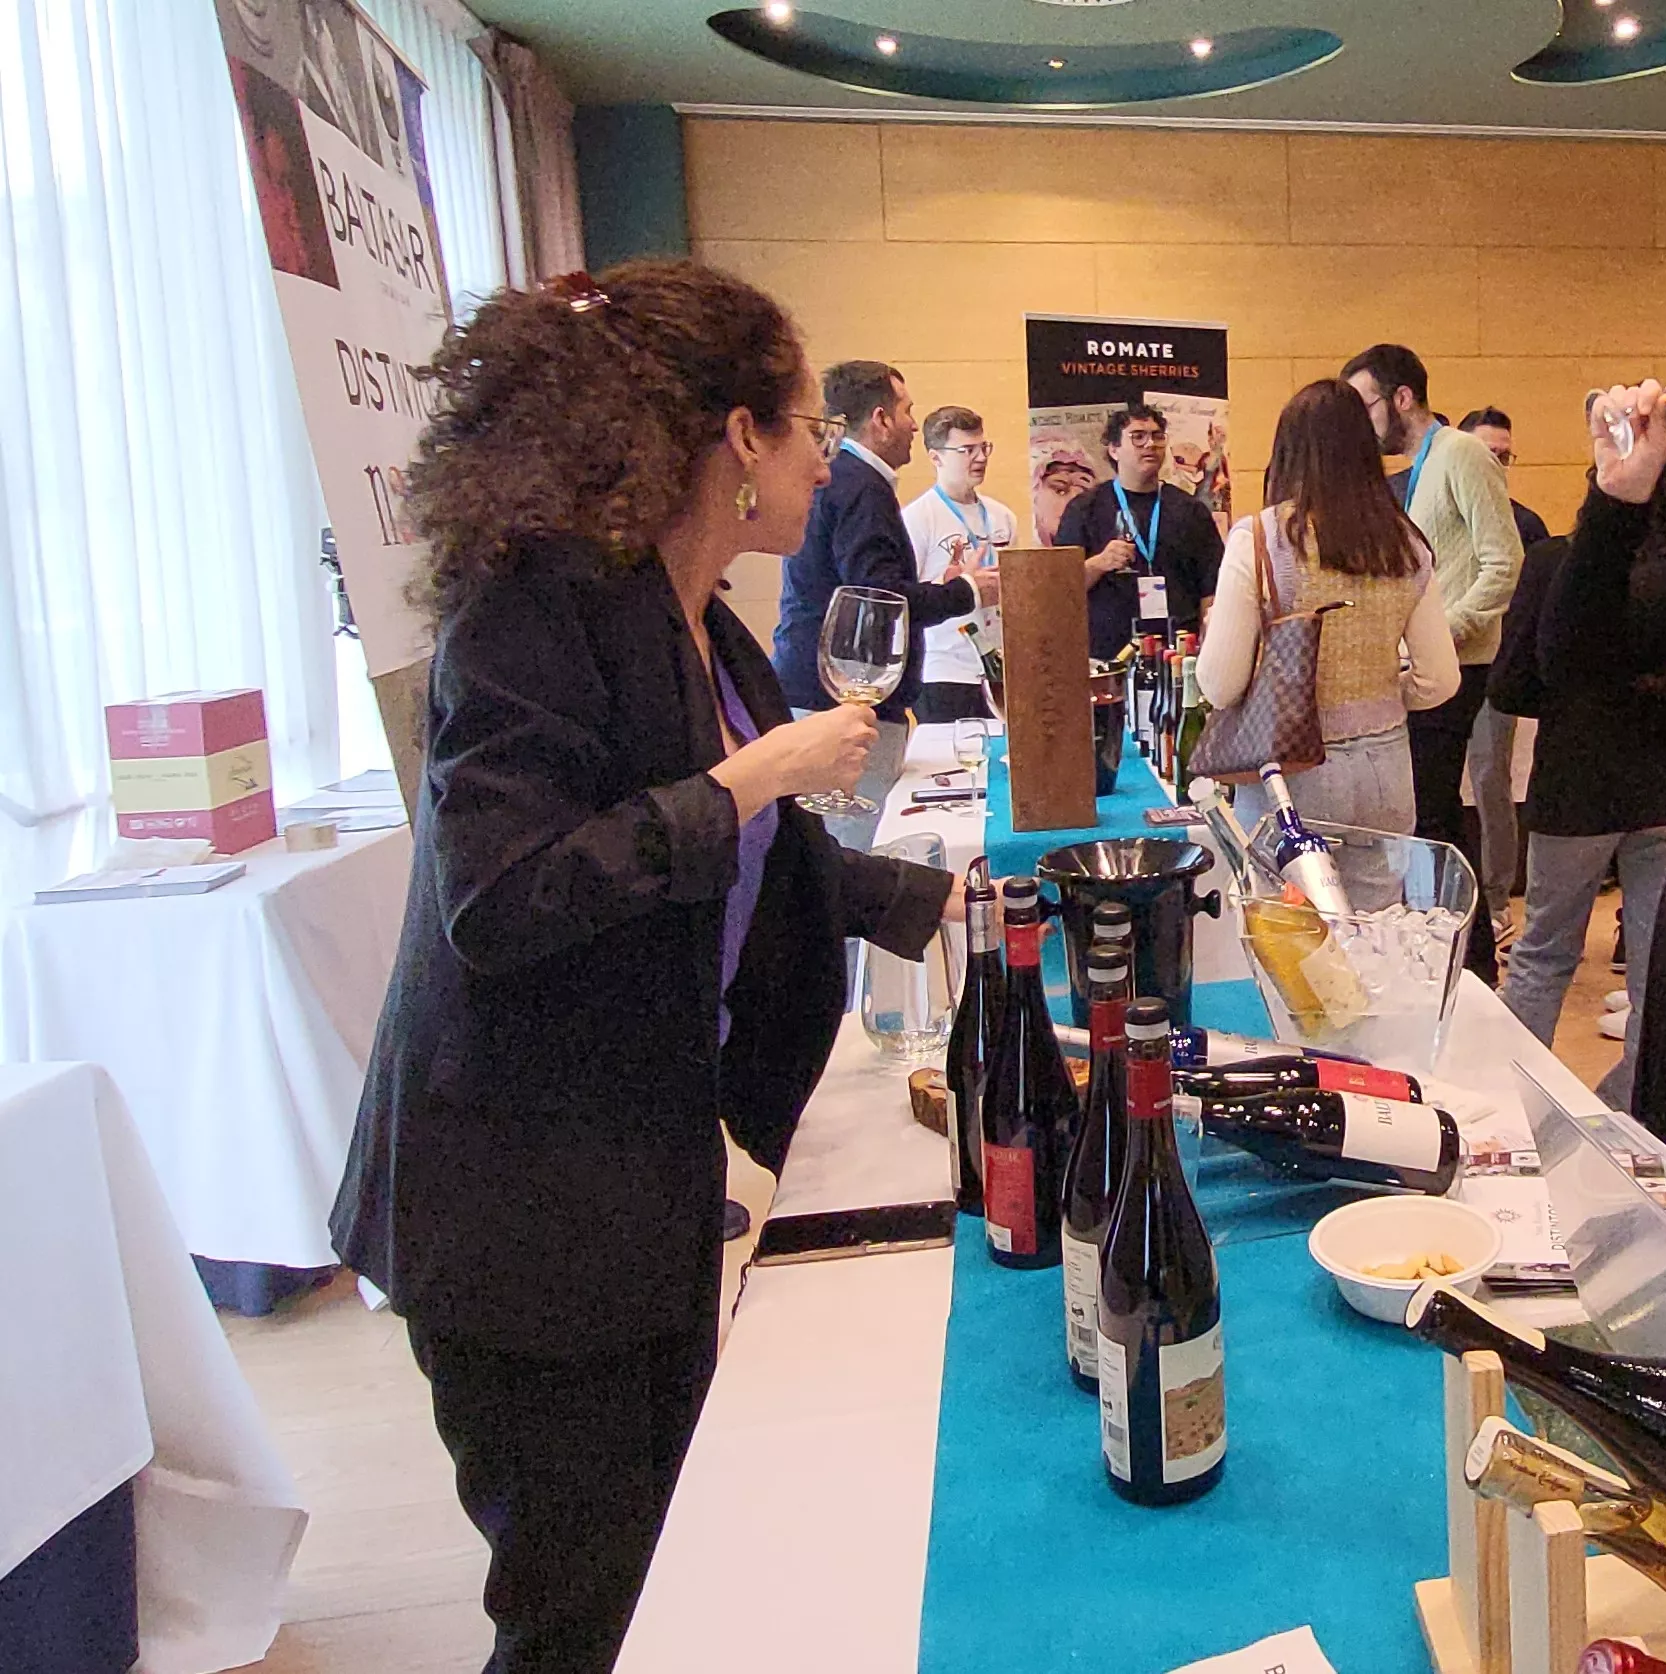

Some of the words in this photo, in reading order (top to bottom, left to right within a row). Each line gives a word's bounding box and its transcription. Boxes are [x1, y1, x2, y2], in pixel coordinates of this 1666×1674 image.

[1087, 340, 1174, 359] ROMATE
[1061, 362, 1126, 376] VINTAGE
[1131, 364, 1199, 379] SHERRIES
